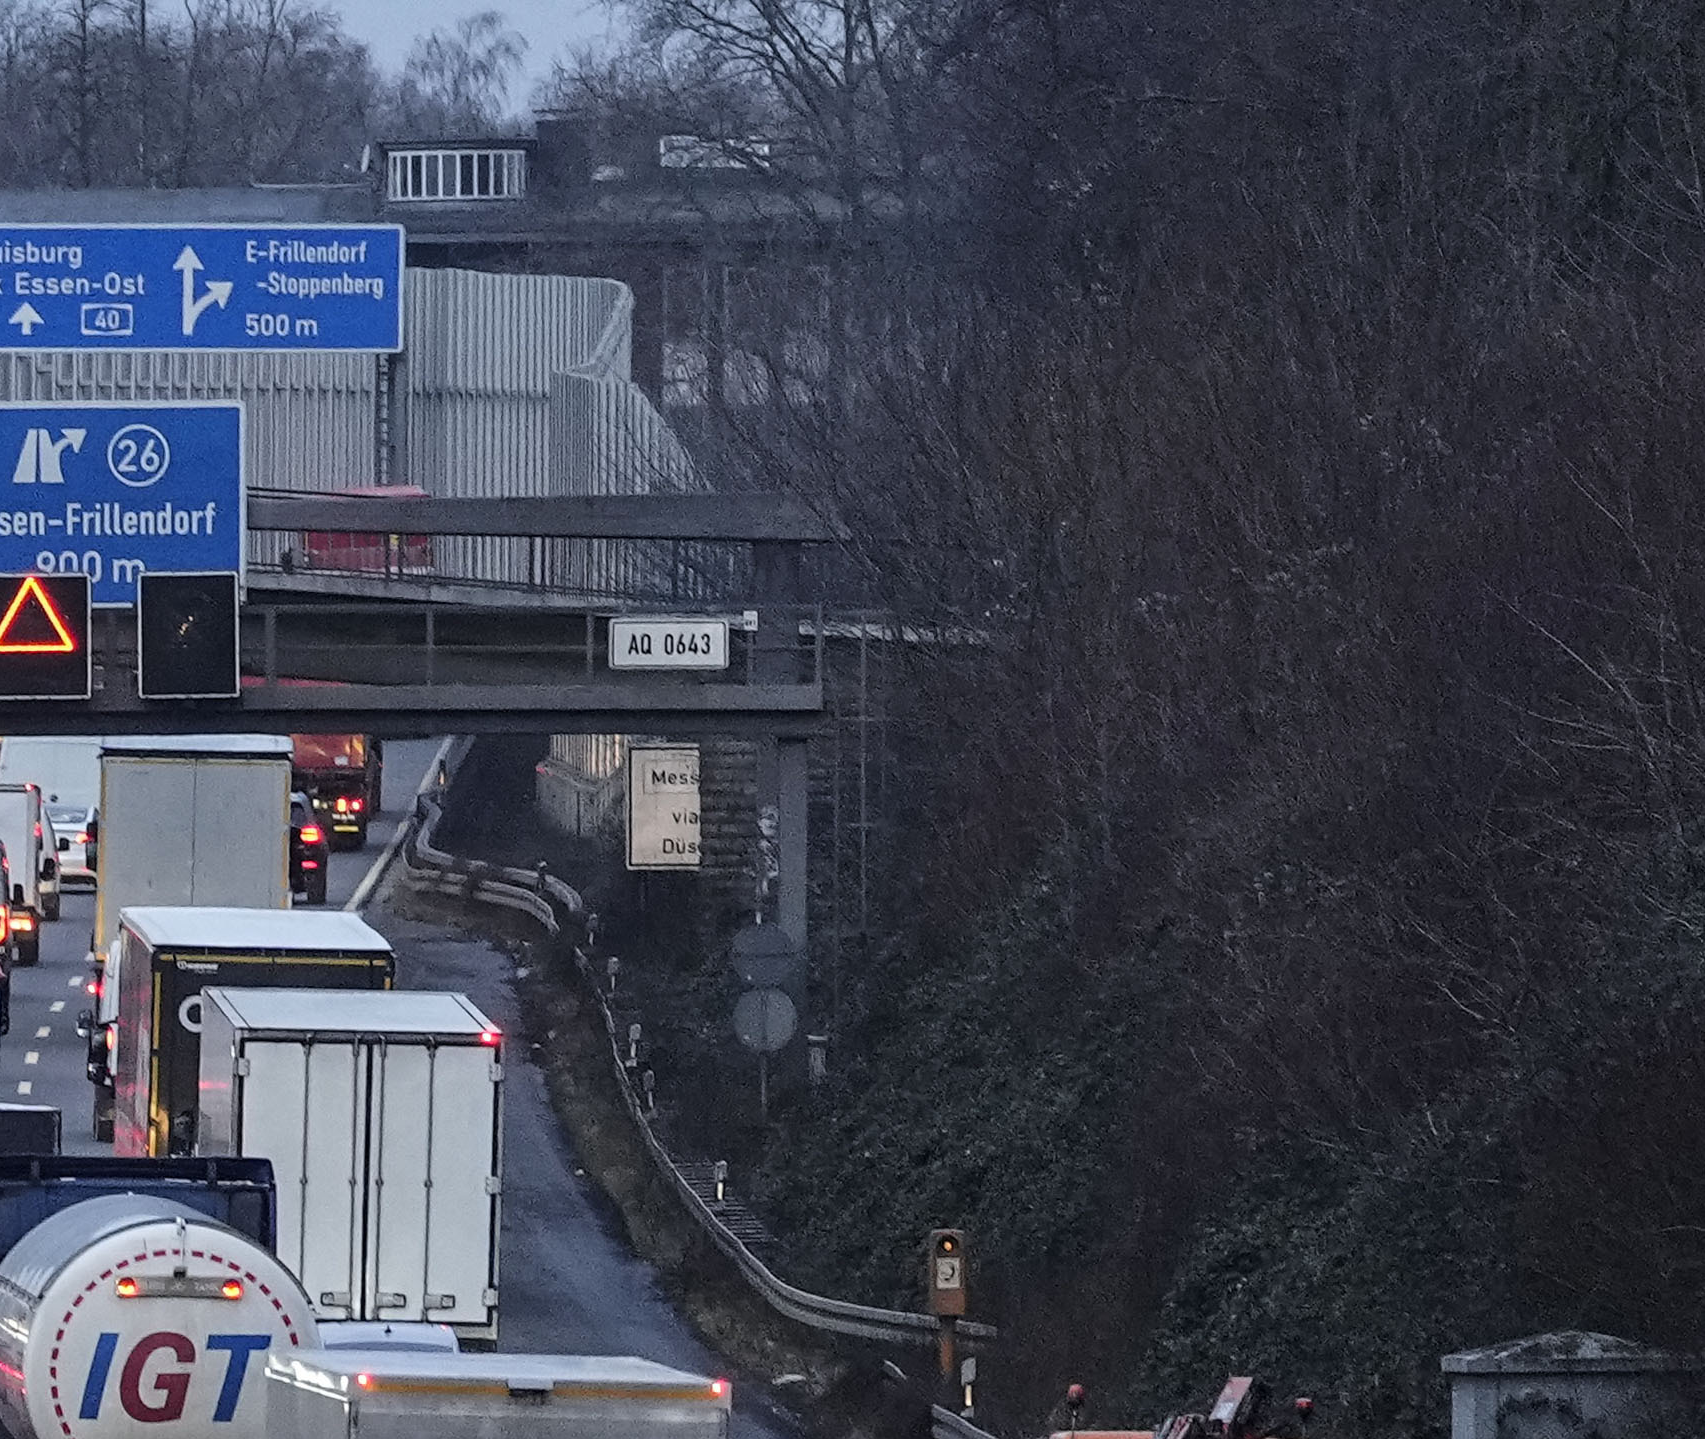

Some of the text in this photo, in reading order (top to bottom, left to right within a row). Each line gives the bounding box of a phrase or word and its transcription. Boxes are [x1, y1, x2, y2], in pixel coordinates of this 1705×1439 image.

[245, 240, 367, 263] E-Frillendorf
[15, 271, 145, 295] Essen-Ost
[256, 271, 384, 300] -Stoppenberg
[94, 310, 121, 329] 40
[245, 313, 318, 336] 500 m
[117, 438, 160, 472] 26
[36, 550, 145, 583] 900 m
[628, 633, 711, 655] AQ 0643
[672, 807, 699, 824] via
[662, 837, 699, 854] Düs
[79, 1331, 272, 1423] IGT
